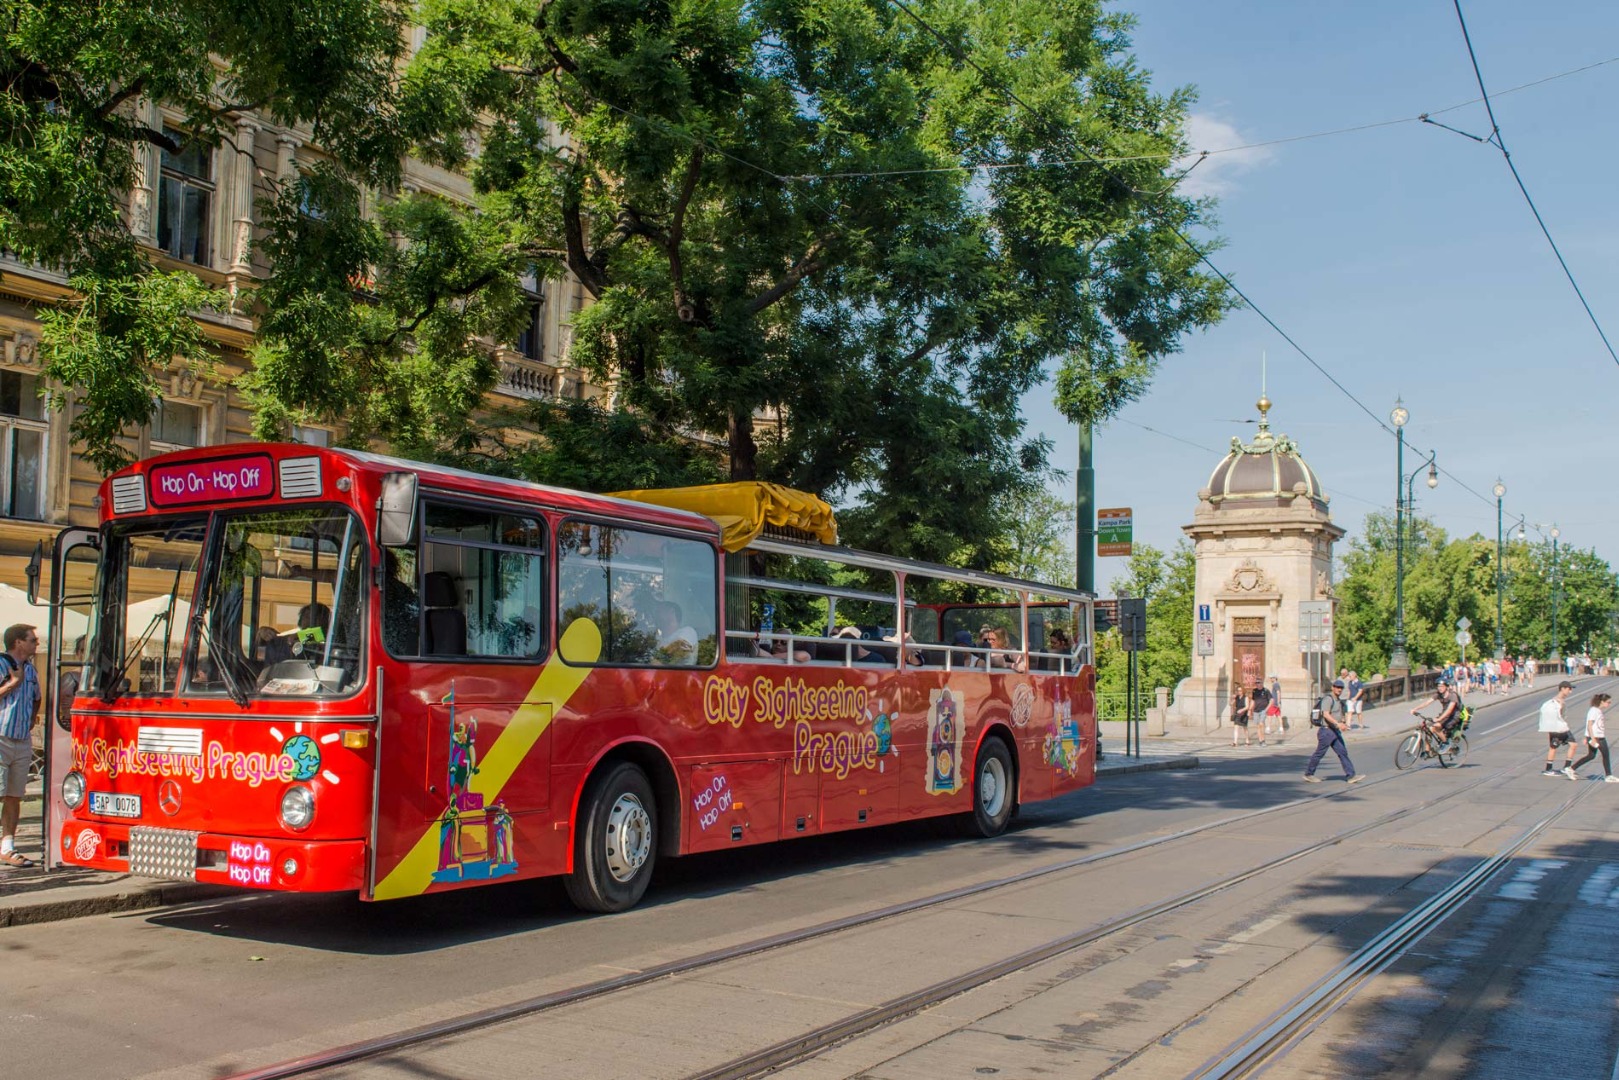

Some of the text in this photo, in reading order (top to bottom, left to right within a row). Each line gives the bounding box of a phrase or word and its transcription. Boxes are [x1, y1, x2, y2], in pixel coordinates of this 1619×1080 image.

[161, 475, 185, 495] Hop
[187, 472, 204, 492] On
[213, 471, 237, 491] Hop
[240, 467, 260, 488] Off
[1110, 534, 1119, 543] A
[703, 674, 868, 729] City Sightseeing
[92, 737, 205, 784] Sightseeing
[208, 740, 295, 787] Prague
[793, 719, 878, 780] Prague
[95, 795, 110, 810] 5AP
[115, 797, 137, 812] 0078
[694, 775, 726, 811] Hop On
[700, 789, 732, 830] Hop Off
[231, 842, 270, 861] Hop On
[230, 865, 271, 884] Hop Off
